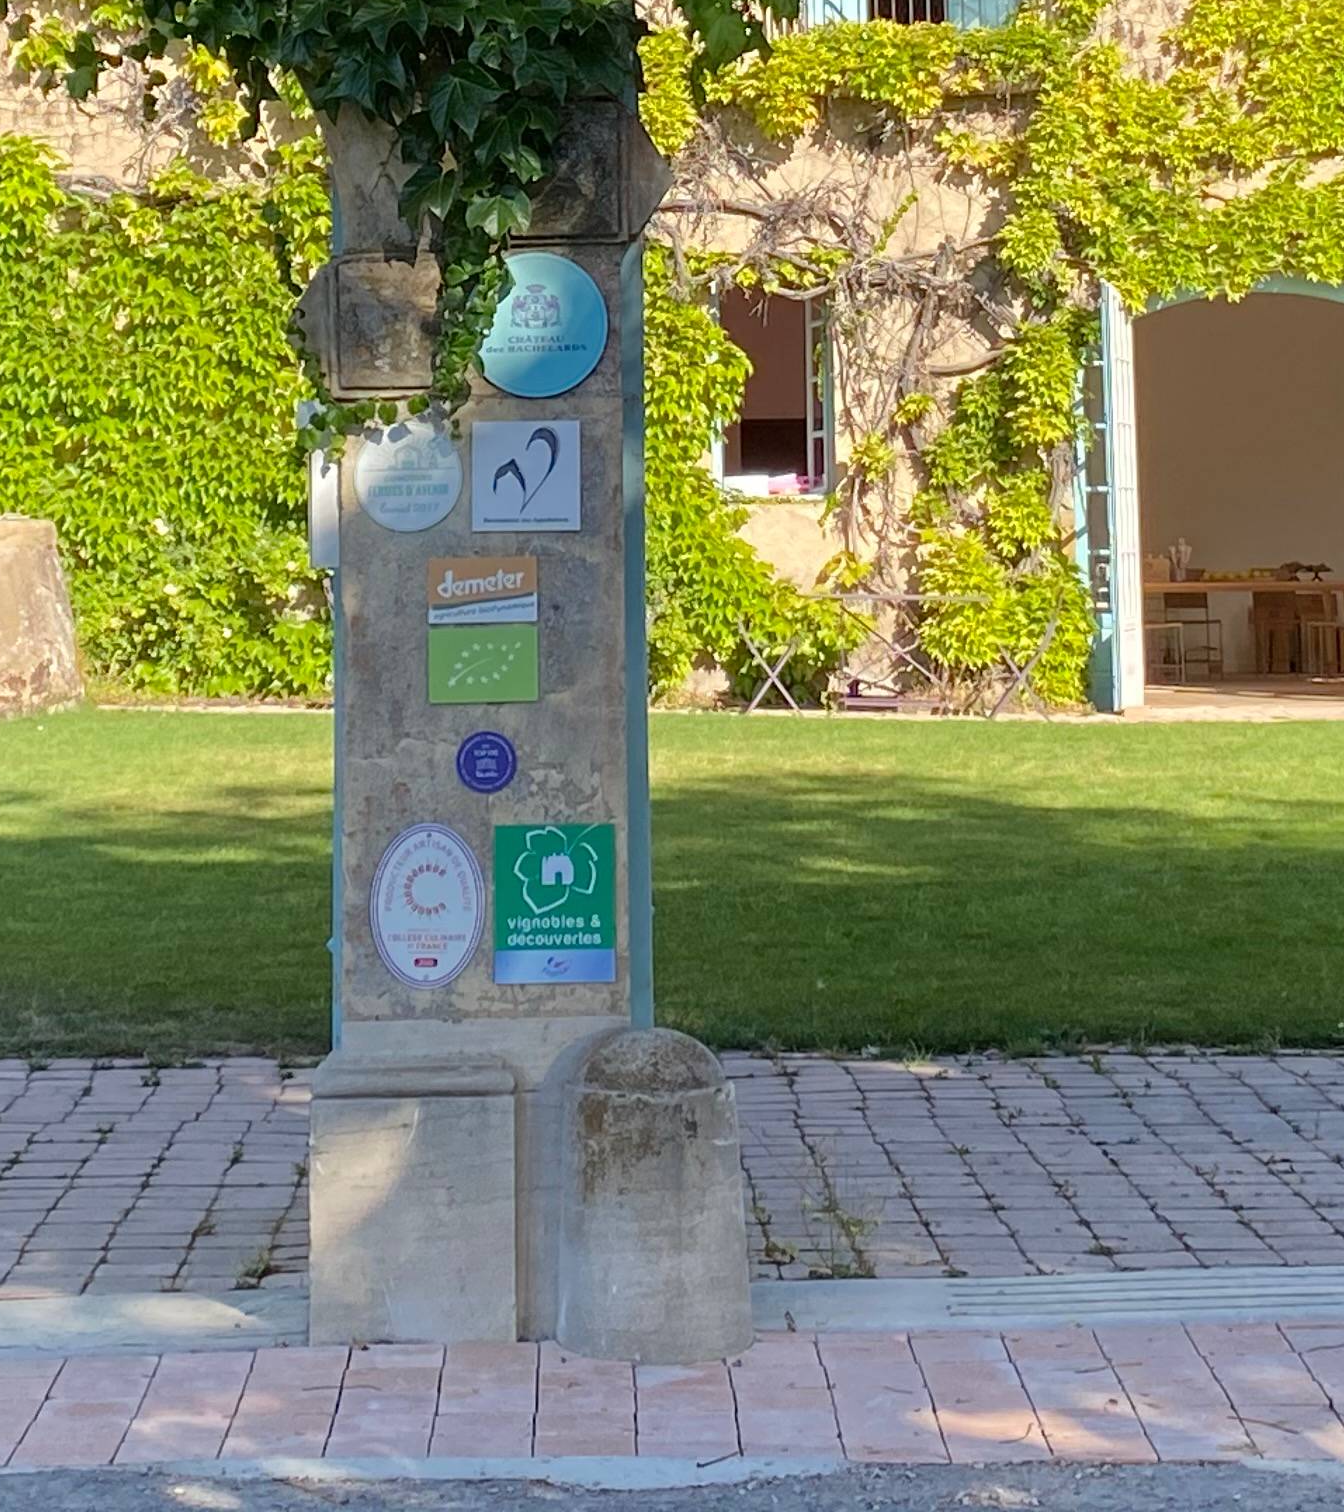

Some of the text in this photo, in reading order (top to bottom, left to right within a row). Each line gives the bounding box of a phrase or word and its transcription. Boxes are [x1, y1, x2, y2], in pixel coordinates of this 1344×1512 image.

[437, 569, 524, 598] demeter
[507, 914, 601, 932] vignobles &
